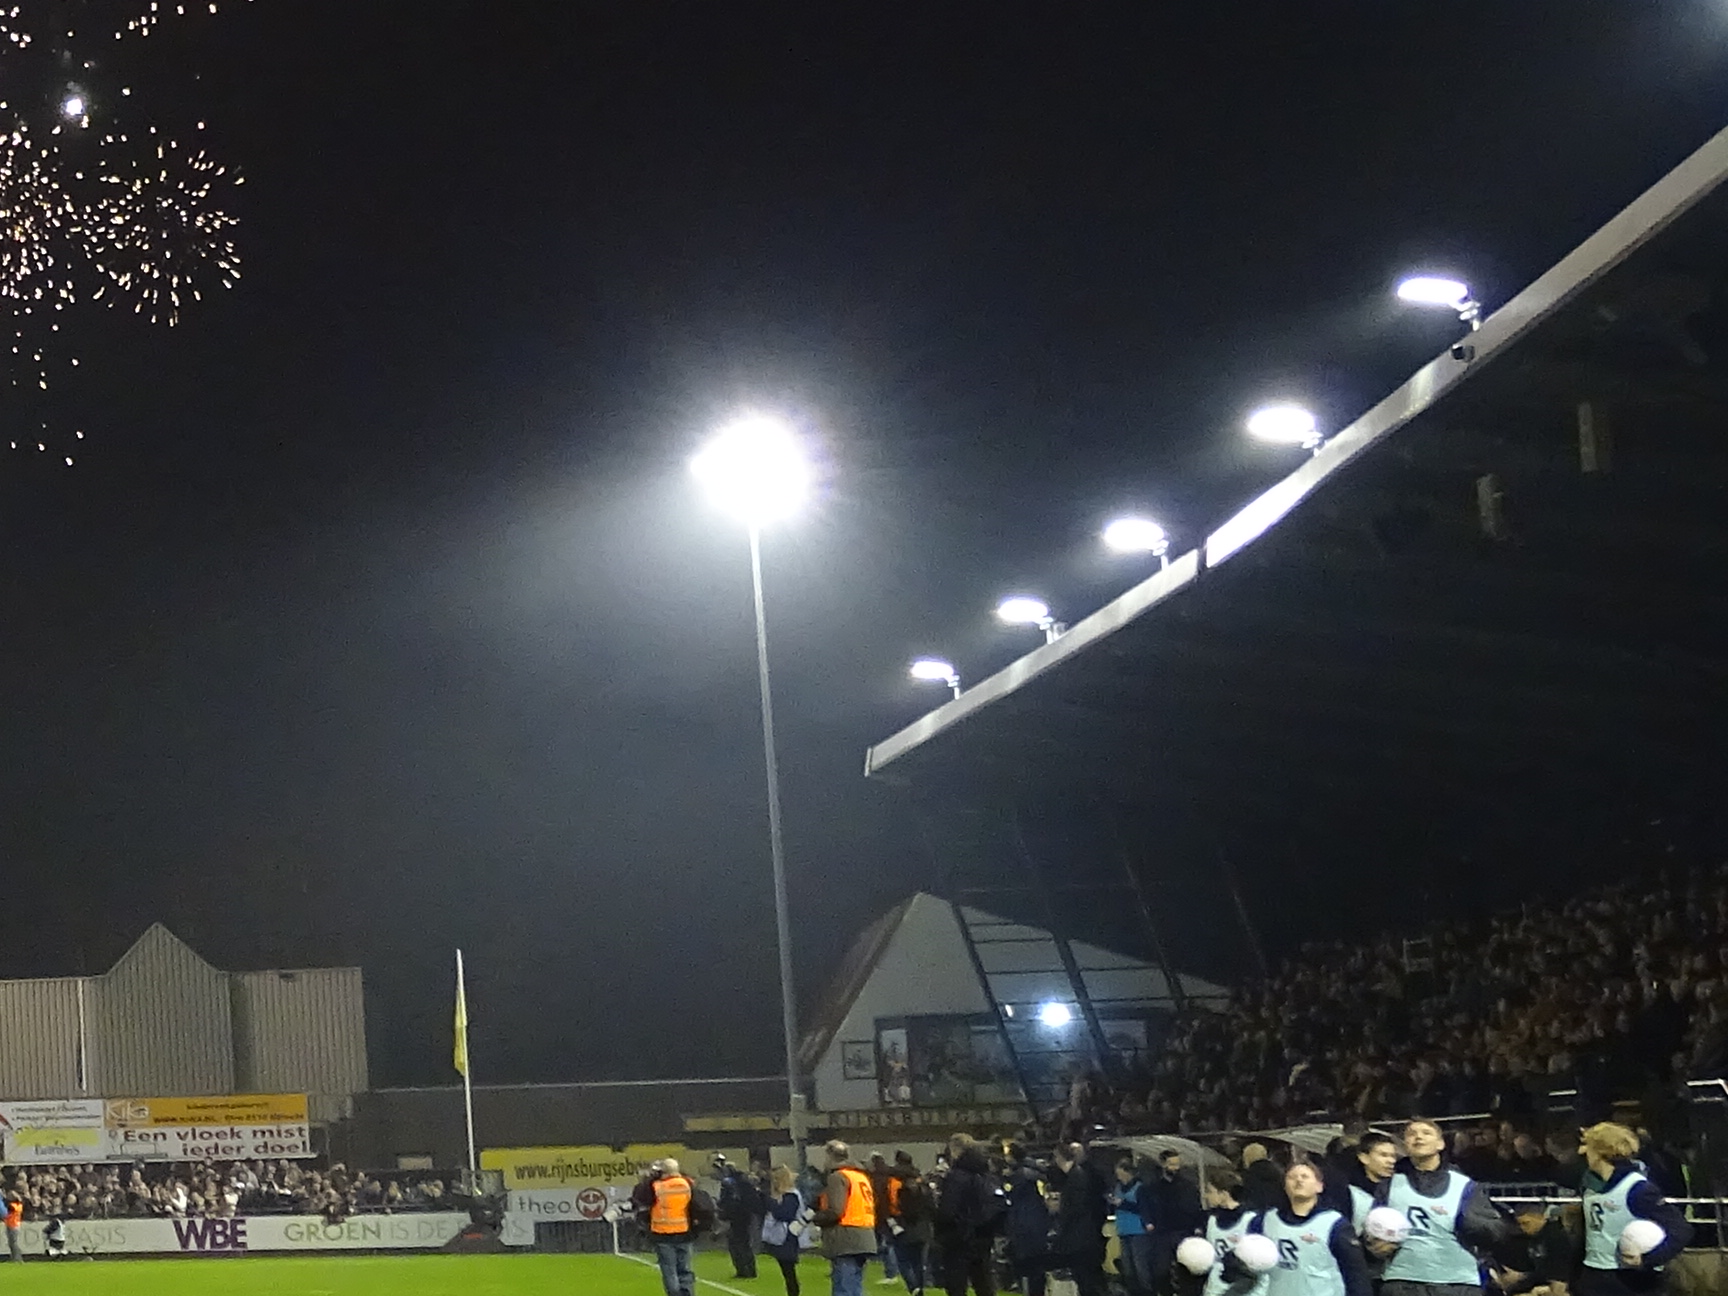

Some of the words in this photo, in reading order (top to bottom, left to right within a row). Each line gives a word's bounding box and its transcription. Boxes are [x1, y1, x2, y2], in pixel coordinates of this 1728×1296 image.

[123, 1131, 167, 1143] Een
[176, 1126, 243, 1142] vloek
[252, 1126, 307, 1139] mist
[182, 1142, 246, 1157] ieder
[253, 1140, 307, 1154] doel
[518, 1194, 572, 1215] theo
[172, 1219, 249, 1251] WBE
[283, 1220, 382, 1242] GROEN
